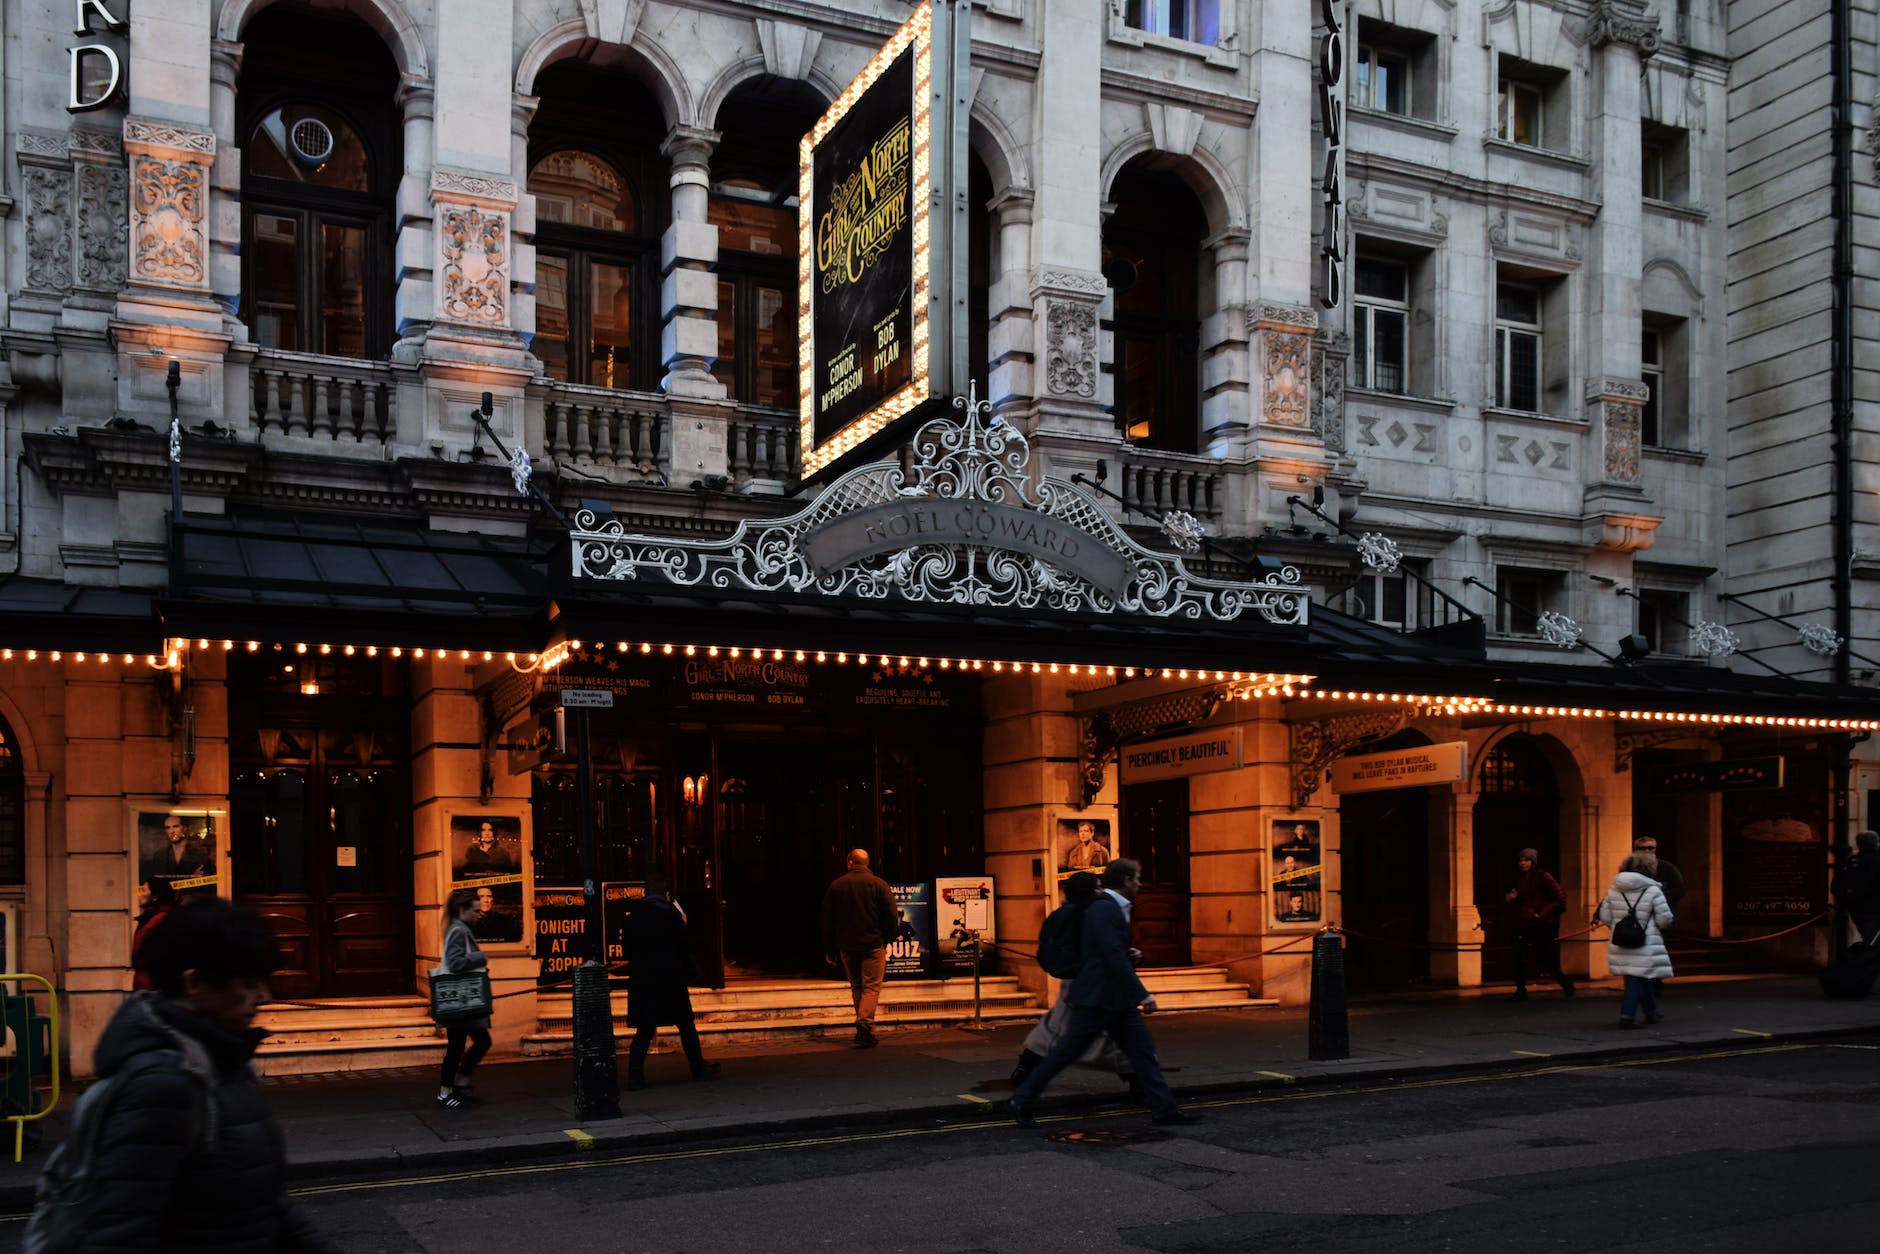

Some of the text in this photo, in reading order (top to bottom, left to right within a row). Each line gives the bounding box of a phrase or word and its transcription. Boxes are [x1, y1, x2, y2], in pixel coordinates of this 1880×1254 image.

[860, 127, 910, 217] NORTH
[817, 207, 852, 272] GIRL
[847, 187, 908, 283] COUNTRY
[878, 321, 895, 350] BOB
[829, 353, 855, 386] CONOR
[873, 340, 900, 375] DYLAN
[955, 511, 1080, 559] COWARD
[585, 677, 614, 687] WEAVES
[616, 679, 627, 688] HIS
[629, 679, 652, 689] MAGIC
[723, 660, 761, 683] NORTH
[762, 662, 809, 688] COUNTRY
[582, 691, 603, 699] loading
[691, 691, 714, 702] CONOR
[767, 694, 781, 704] BOB
[783, 695, 805, 705] DYLAN
[856, 695, 894, 705] EXQUISITELY
[1367, 769, 1383, 779] LEAVE
[905, 886, 921, 894] NOW
[551, 938, 569, 954] AT
